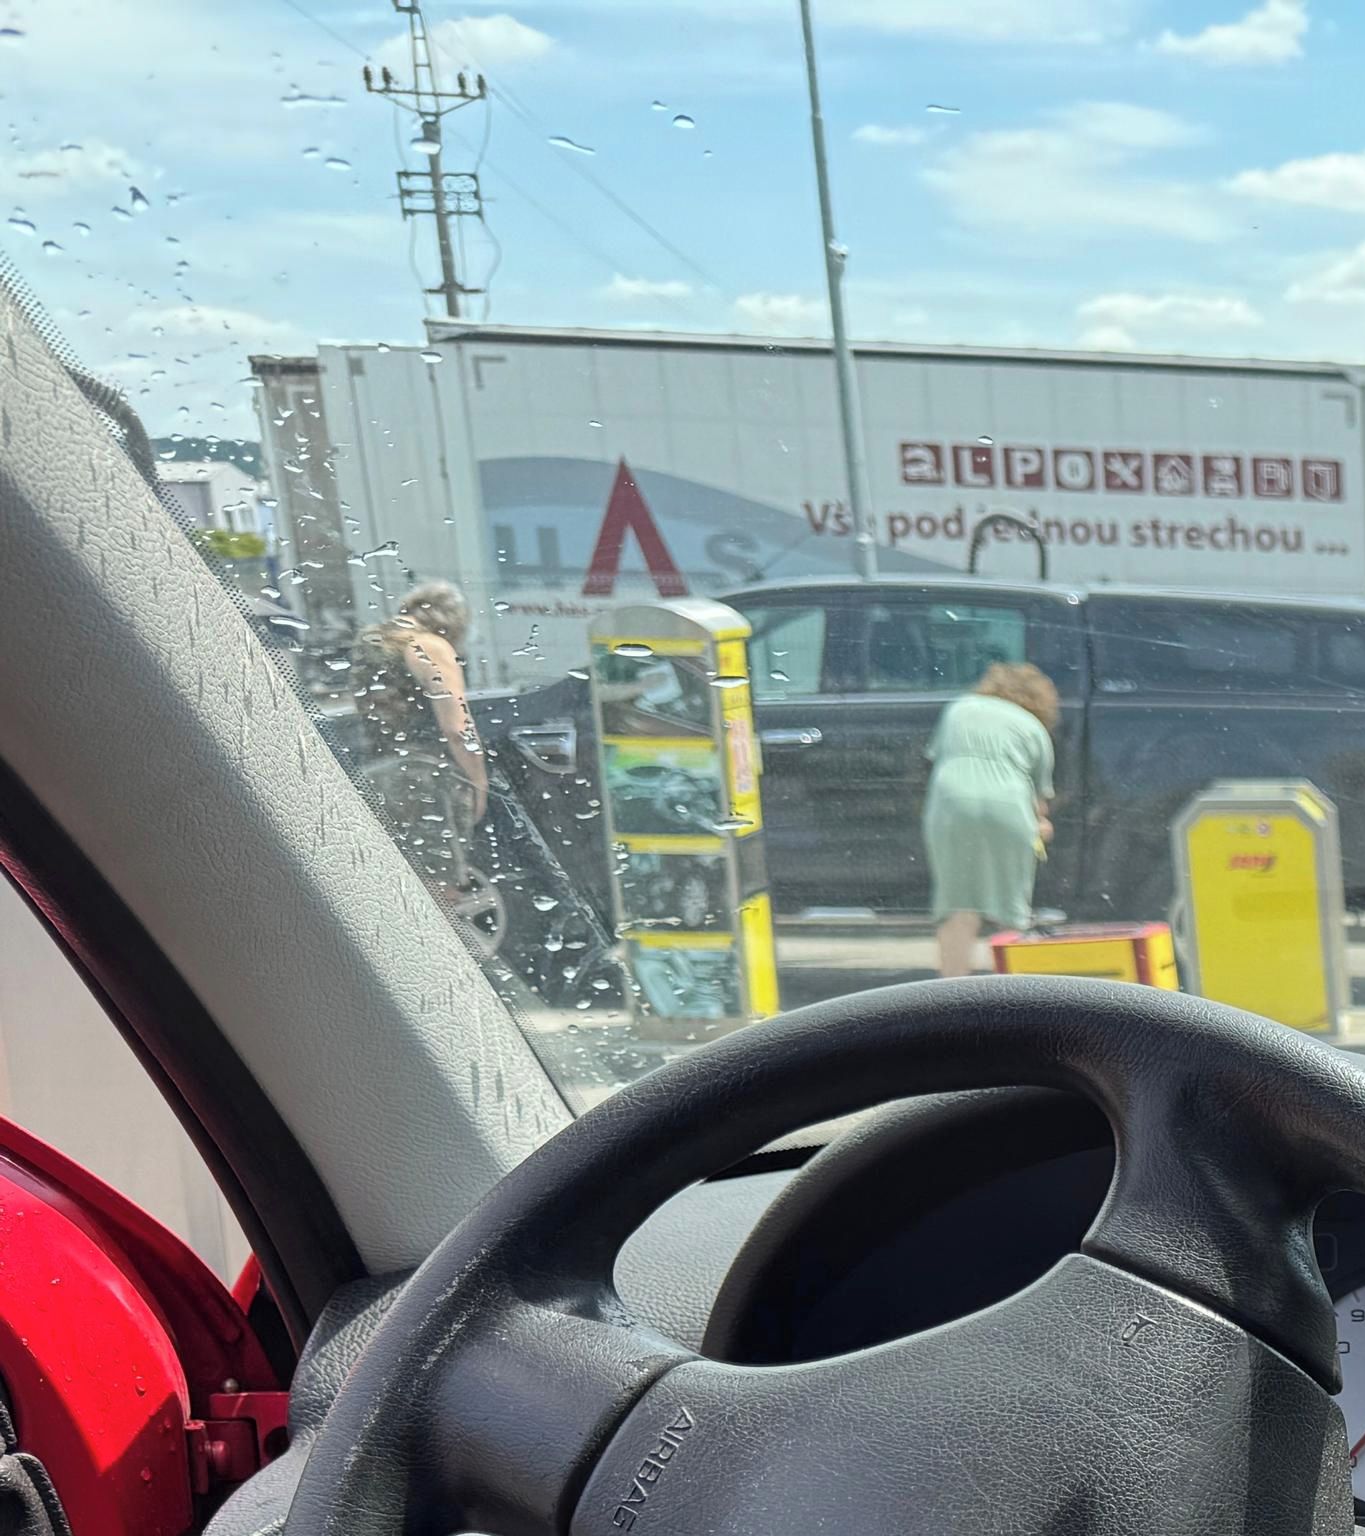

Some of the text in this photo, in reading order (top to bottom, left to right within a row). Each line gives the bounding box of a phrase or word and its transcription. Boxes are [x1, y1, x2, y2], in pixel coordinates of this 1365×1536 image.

[804, 498, 876, 537] Vš
[887, 503, 965, 547] pod
[1131, 515, 1302, 552] strechou
[613, 1406, 695, 1532] AIRBAG
